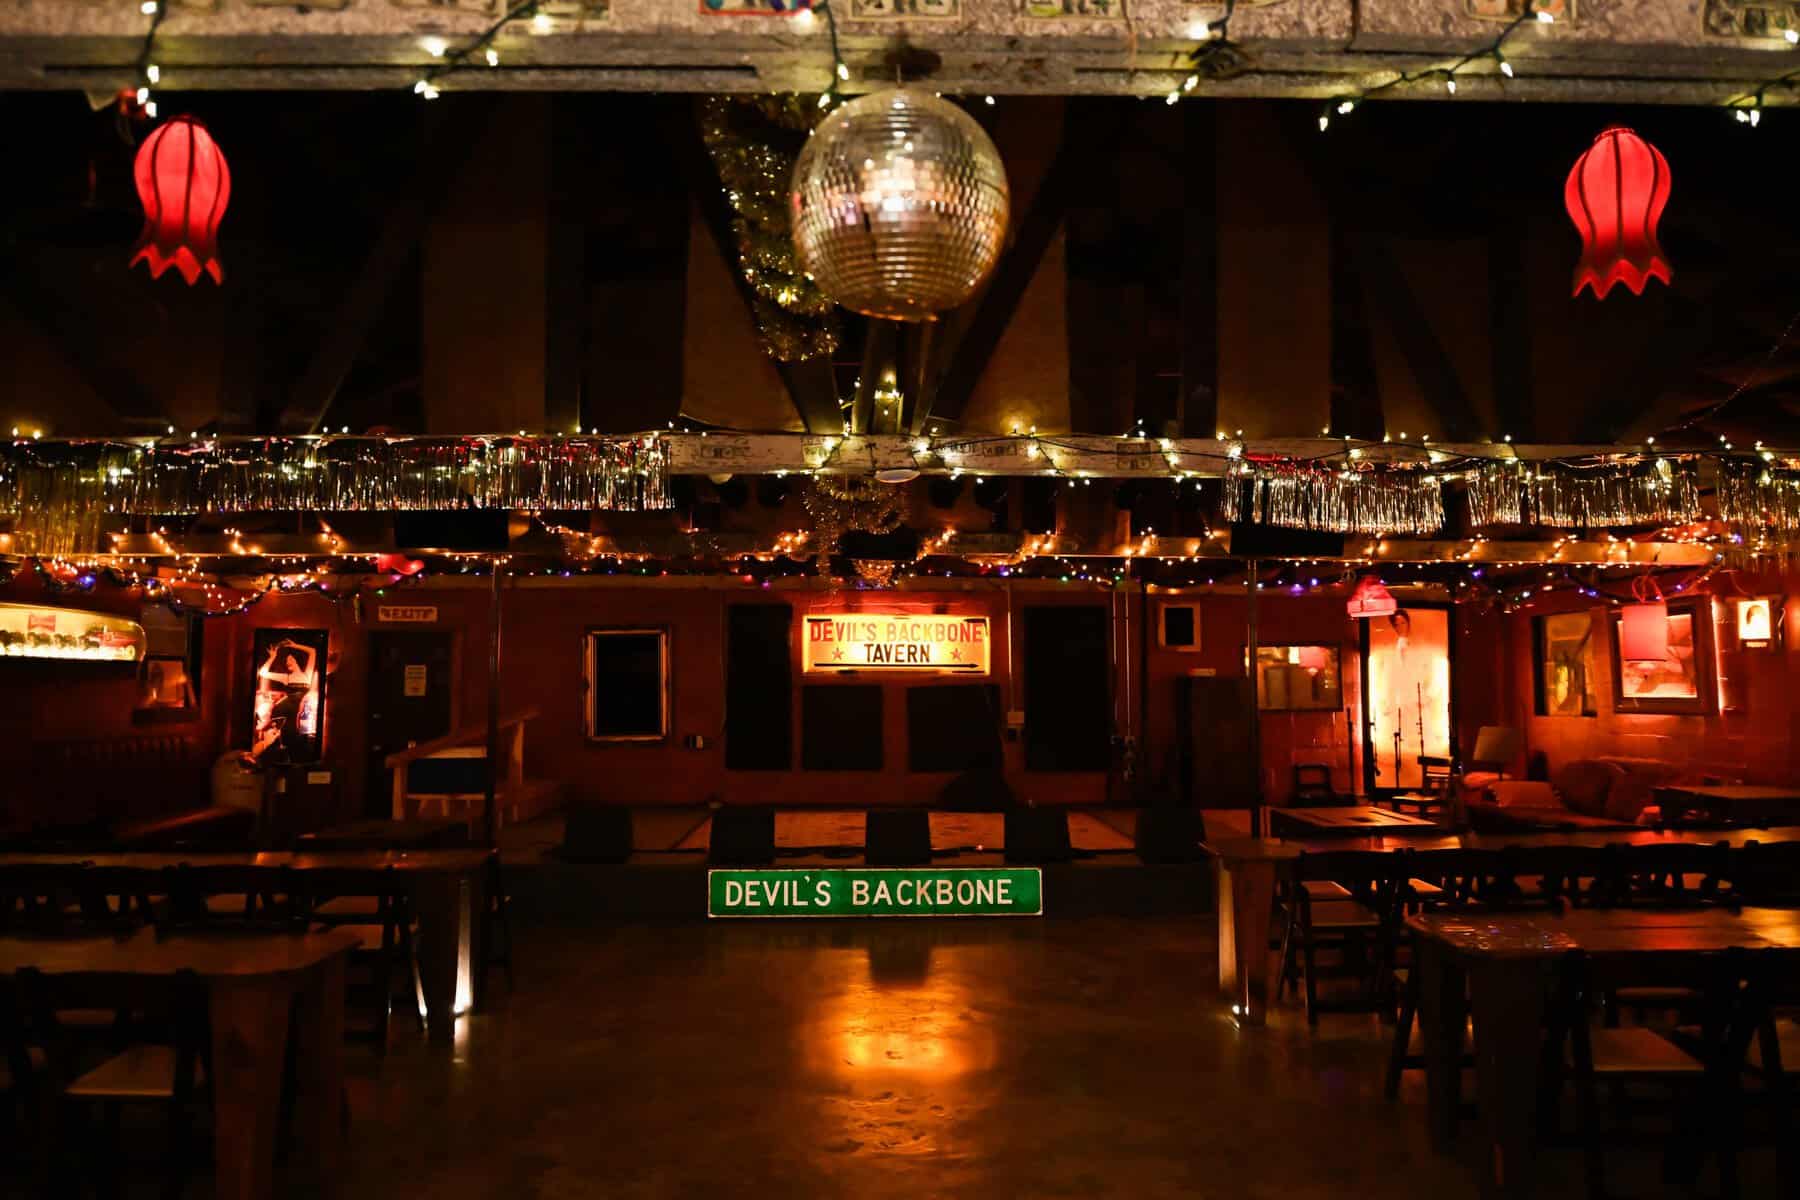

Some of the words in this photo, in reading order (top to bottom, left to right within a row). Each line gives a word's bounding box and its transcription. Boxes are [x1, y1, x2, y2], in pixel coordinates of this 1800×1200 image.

[810, 622, 877, 642] DEVIL'S
[886, 622, 985, 642] BACKBONE
[864, 643, 931, 663] TAVERN
[725, 875, 832, 907] DEVIL'S
[851, 878, 1013, 906] BACKBONE
